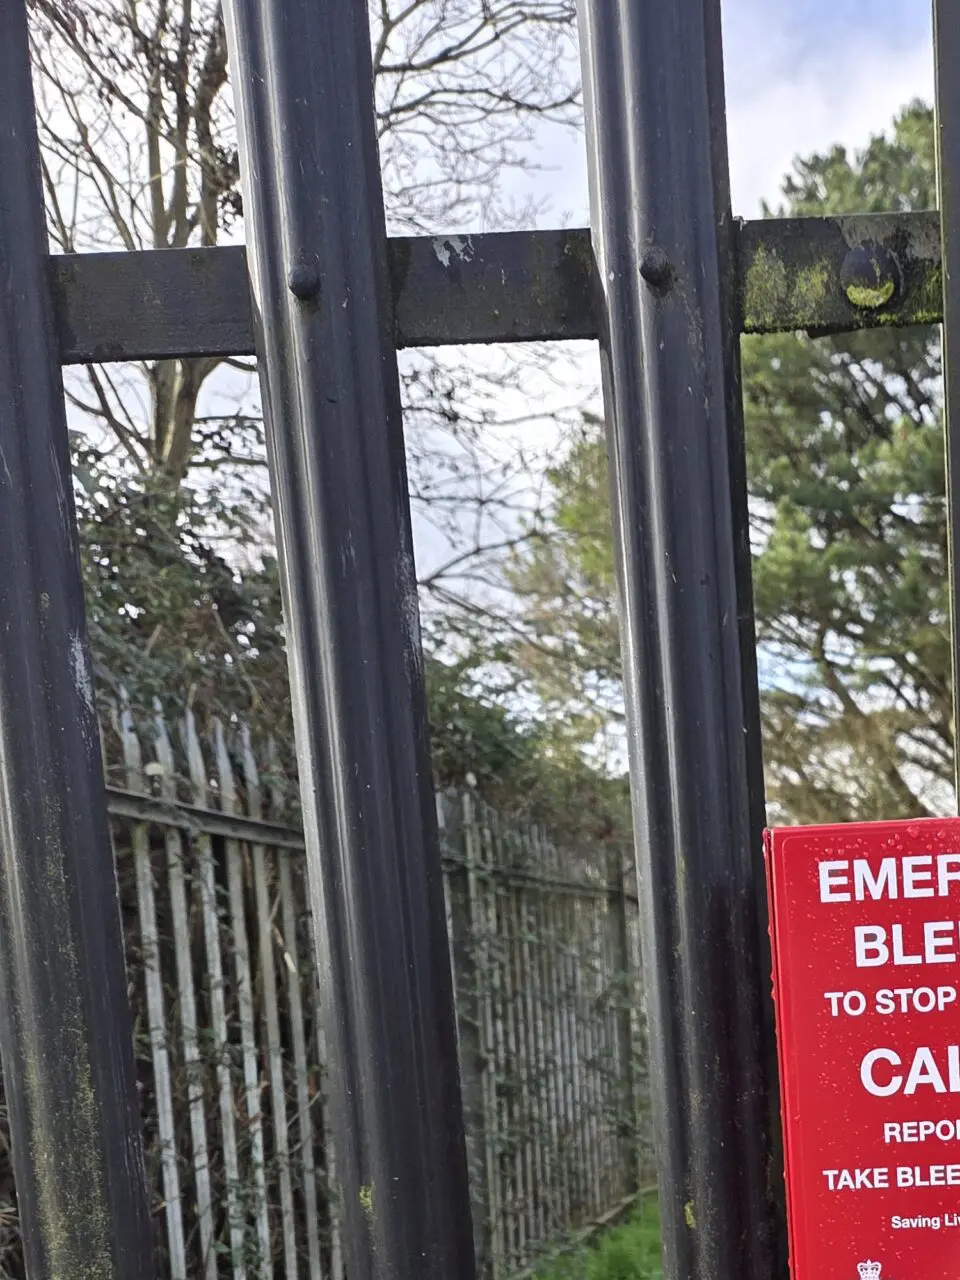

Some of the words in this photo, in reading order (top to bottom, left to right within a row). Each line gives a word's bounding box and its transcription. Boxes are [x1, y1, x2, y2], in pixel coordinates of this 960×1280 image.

[824, 991, 866, 1016] TO
[876, 987, 956, 1014] STOP
[823, 1168, 888, 1190] TAKE
[892, 1216, 940, 1229] Saving
